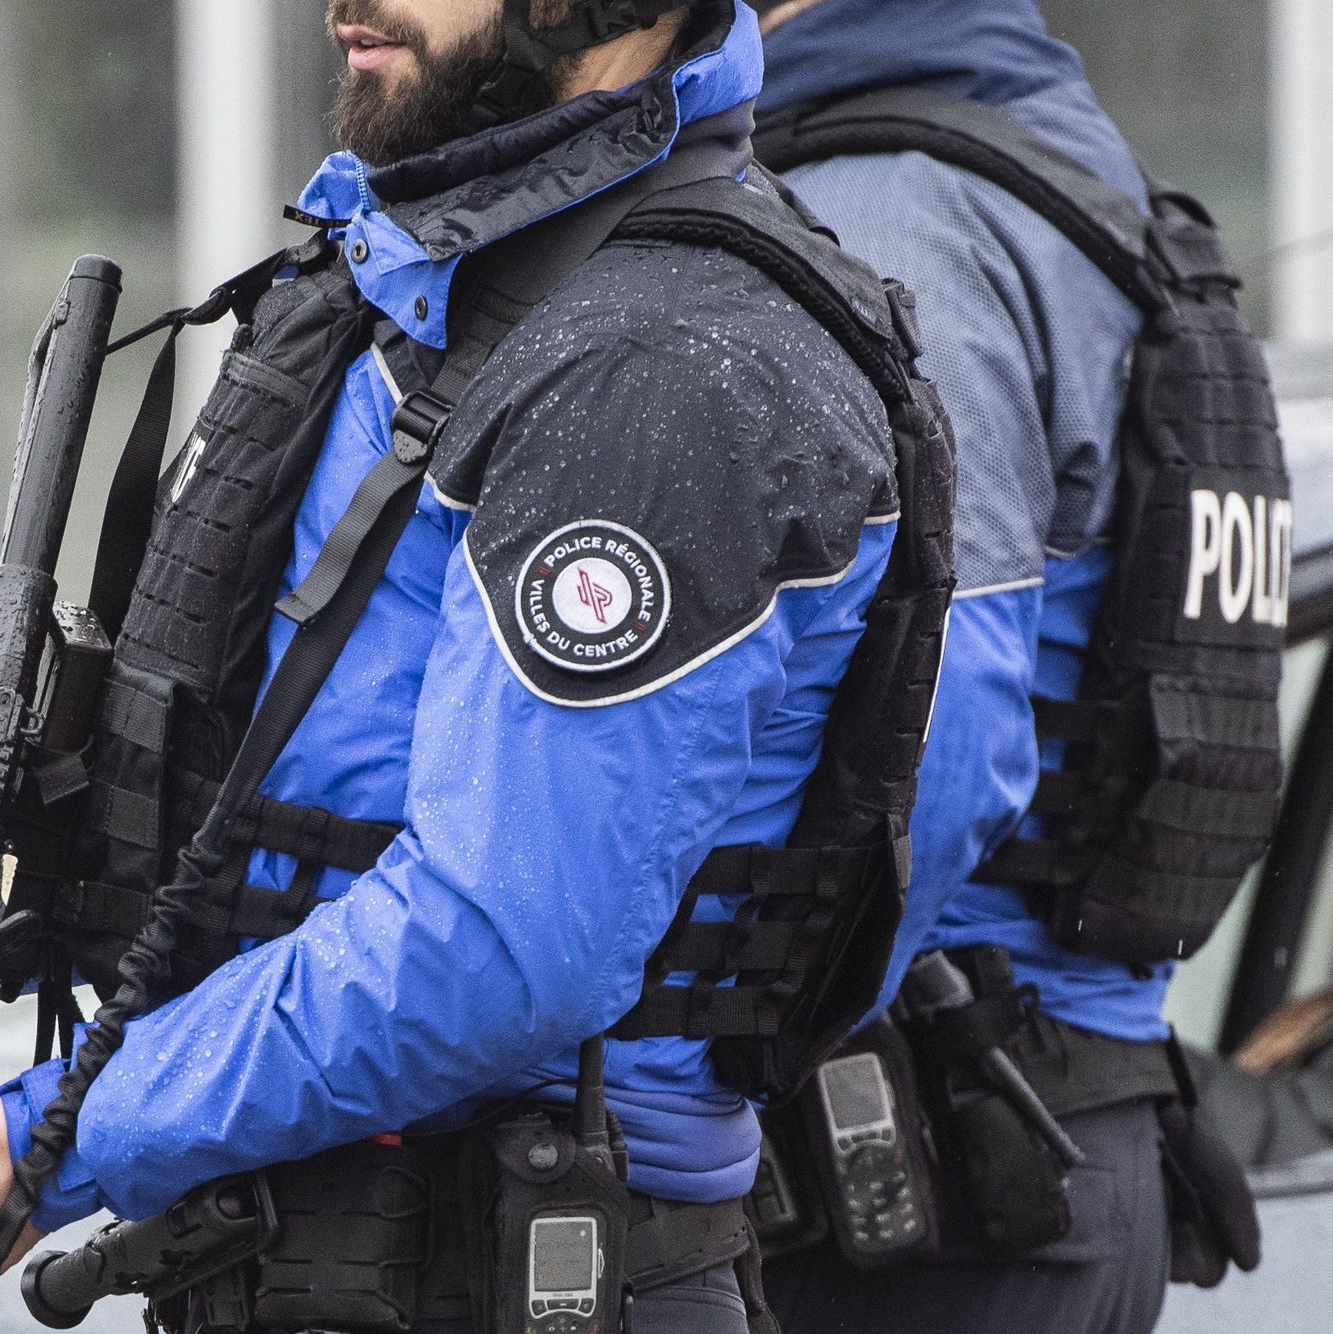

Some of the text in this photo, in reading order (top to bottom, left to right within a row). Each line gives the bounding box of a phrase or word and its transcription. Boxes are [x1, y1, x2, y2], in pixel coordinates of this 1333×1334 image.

[529, 579, 639, 657] VILLES DU CENTRE
[543, 536, 654, 622] POLICE RÉGIONALE
